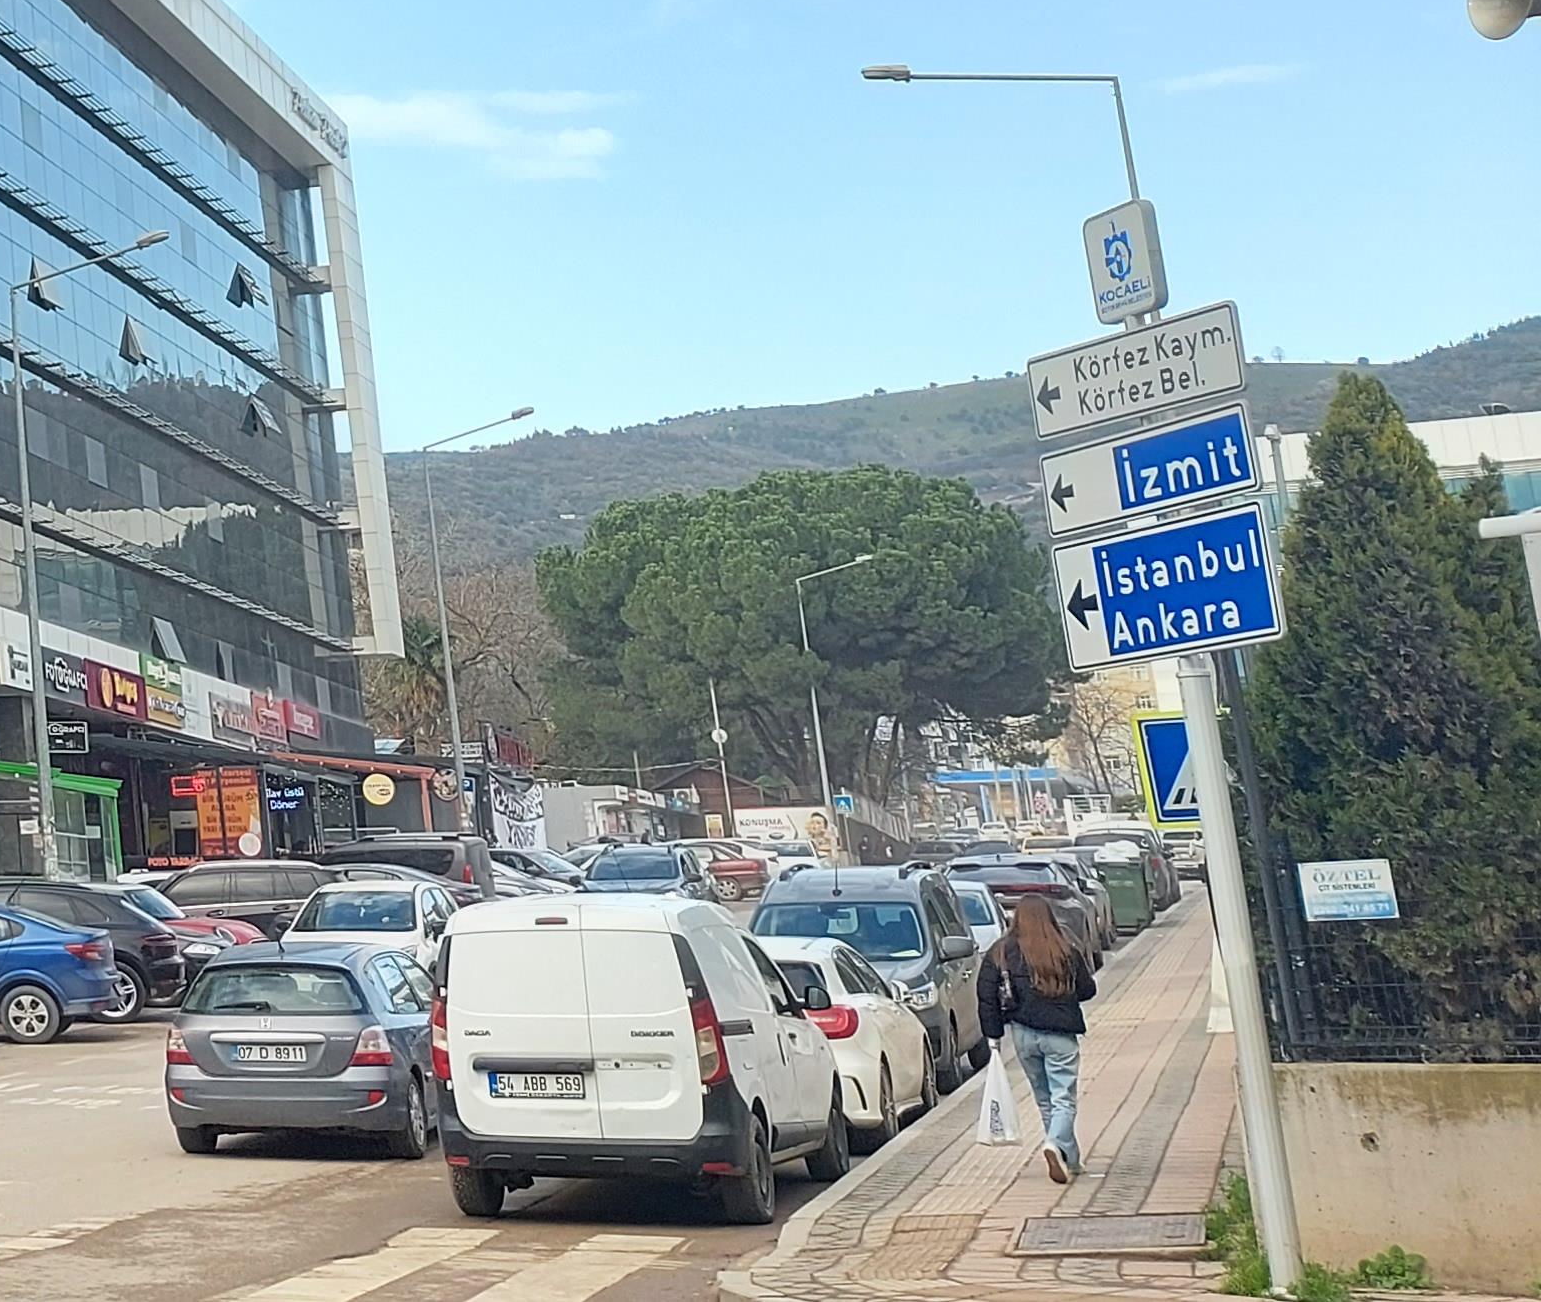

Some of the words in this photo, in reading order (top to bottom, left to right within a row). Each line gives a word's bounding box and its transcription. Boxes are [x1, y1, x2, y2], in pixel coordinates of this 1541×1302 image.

[1098, 275, 1152, 305] KOCAELİ
[1073, 346, 1150, 383] Körfez
[1154, 326, 1232, 361] Kaym.
[1078, 380, 1155, 416] Körfez
[1160, 361, 1206, 394] Bel.
[1122, 436, 1242, 503] İzmit
[1101, 529, 1260, 597] İstanbul
[1113, 599, 1241, 649] Ankara
[238, 1046, 253, 1059] 07
[259, 1047, 269, 1059] D
[275, 1047, 305, 1059] 8911
[498, 1075, 514, 1091] 54
[523, 1076, 548, 1091] ABB
[555, 1076, 582, 1091] 569
